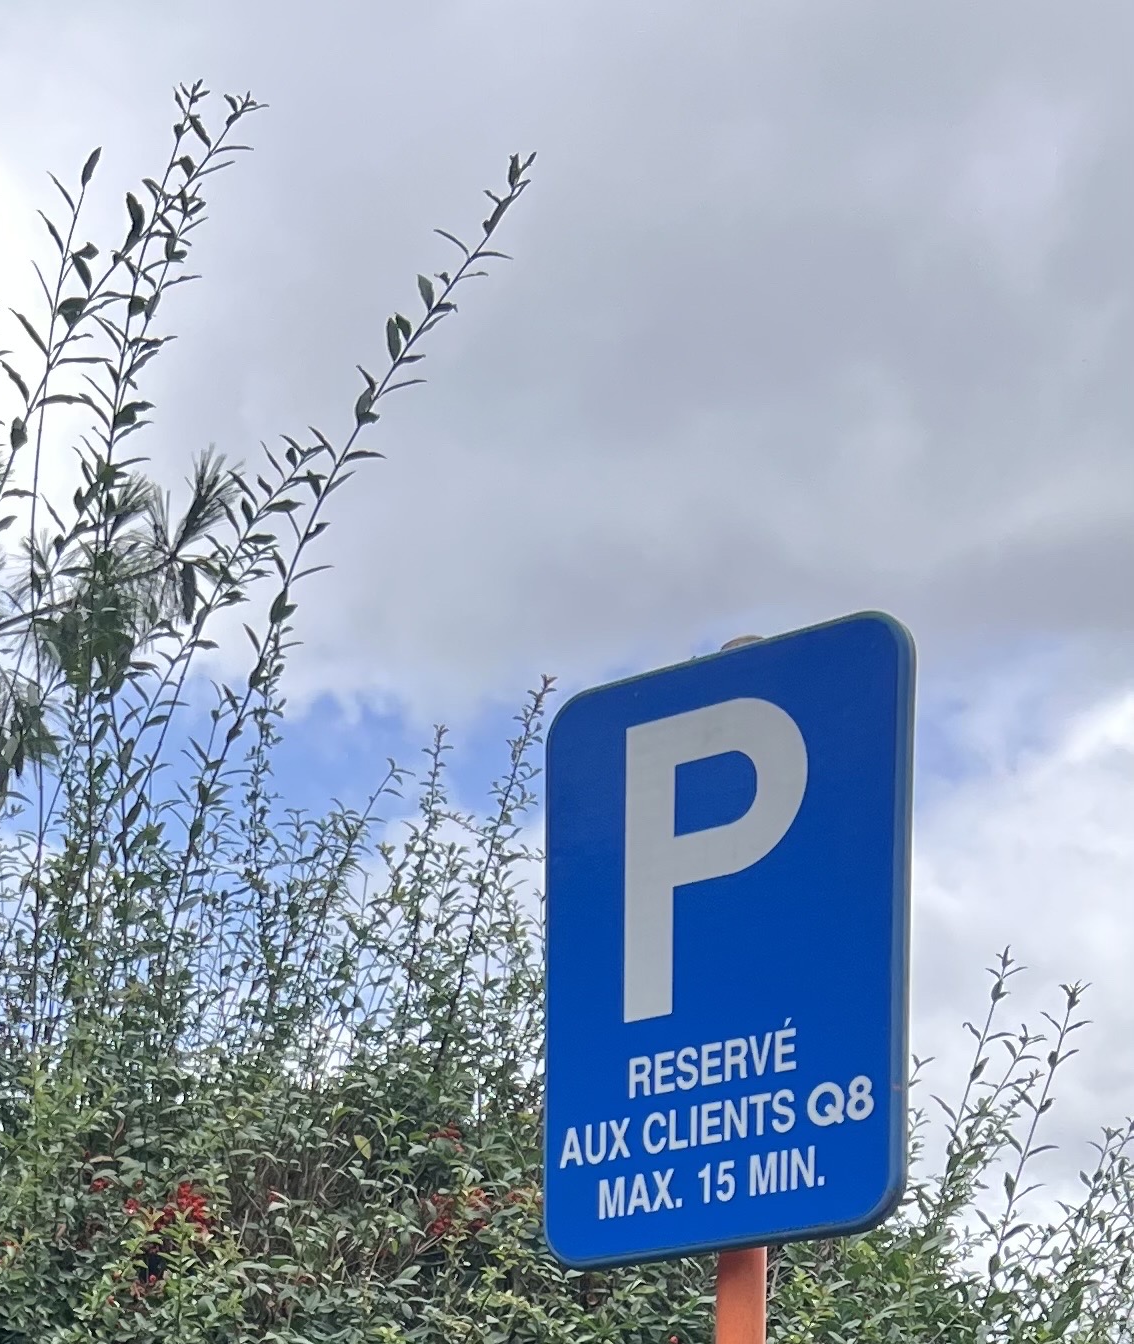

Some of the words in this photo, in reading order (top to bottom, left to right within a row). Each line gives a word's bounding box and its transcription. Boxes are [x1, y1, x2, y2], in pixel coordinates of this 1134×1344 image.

[623, 697, 808, 1023] P
[627, 1018, 797, 1099] RESERVÉ
[559, 1119, 630, 1169] AUX
[642, 1088, 796, 1154] CLIENTS
[806, 1075, 875, 1128] Q8
[598, 1168, 683, 1220] MAX.
[697, 1158, 736, 1203] 15
[748, 1145, 825, 1197] MIN.
